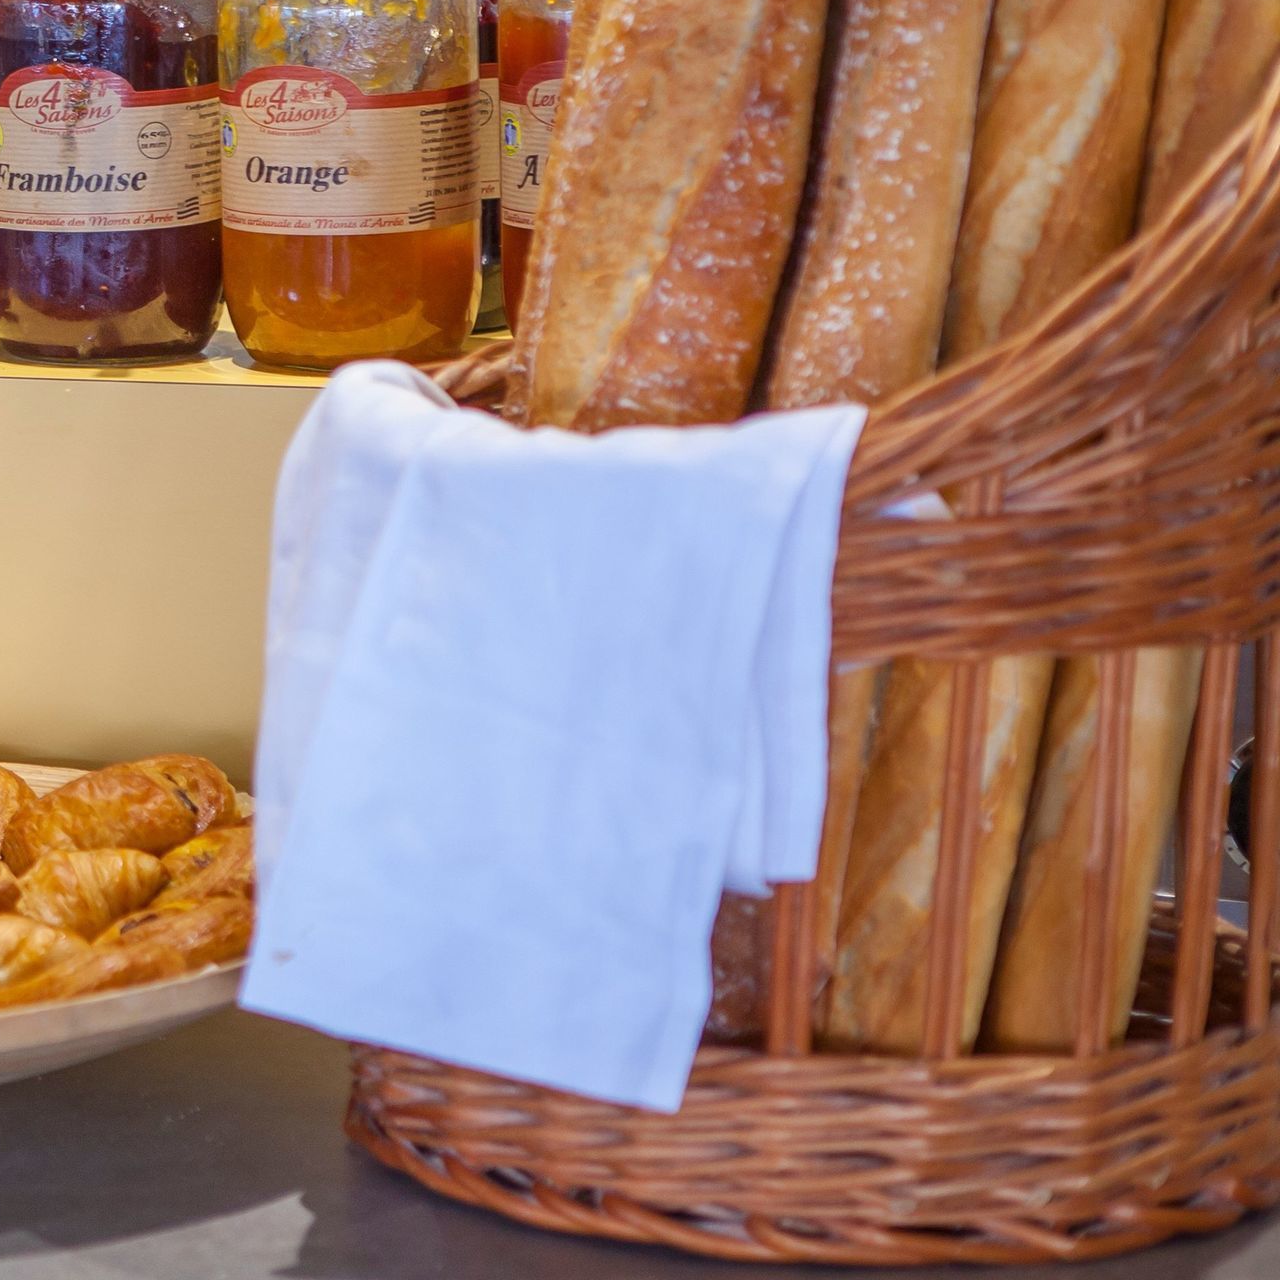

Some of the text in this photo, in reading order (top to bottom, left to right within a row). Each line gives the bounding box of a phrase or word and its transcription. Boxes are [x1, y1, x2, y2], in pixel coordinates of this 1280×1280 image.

[16, 81, 61, 109] Les 4
[246, 81, 288, 110] Les 4
[532, 88, 555, 107] Les
[264, 104, 338, 124] Saisons
[246, 156, 349, 191] Orange
[517, 155, 540, 189] A
[16, 216, 65, 226] artisanale
[67, 218, 86, 227] des
[89, 216, 130, 226] Monts
[294, 219, 311, 228] des
[315, 218, 357, 229] Monts
